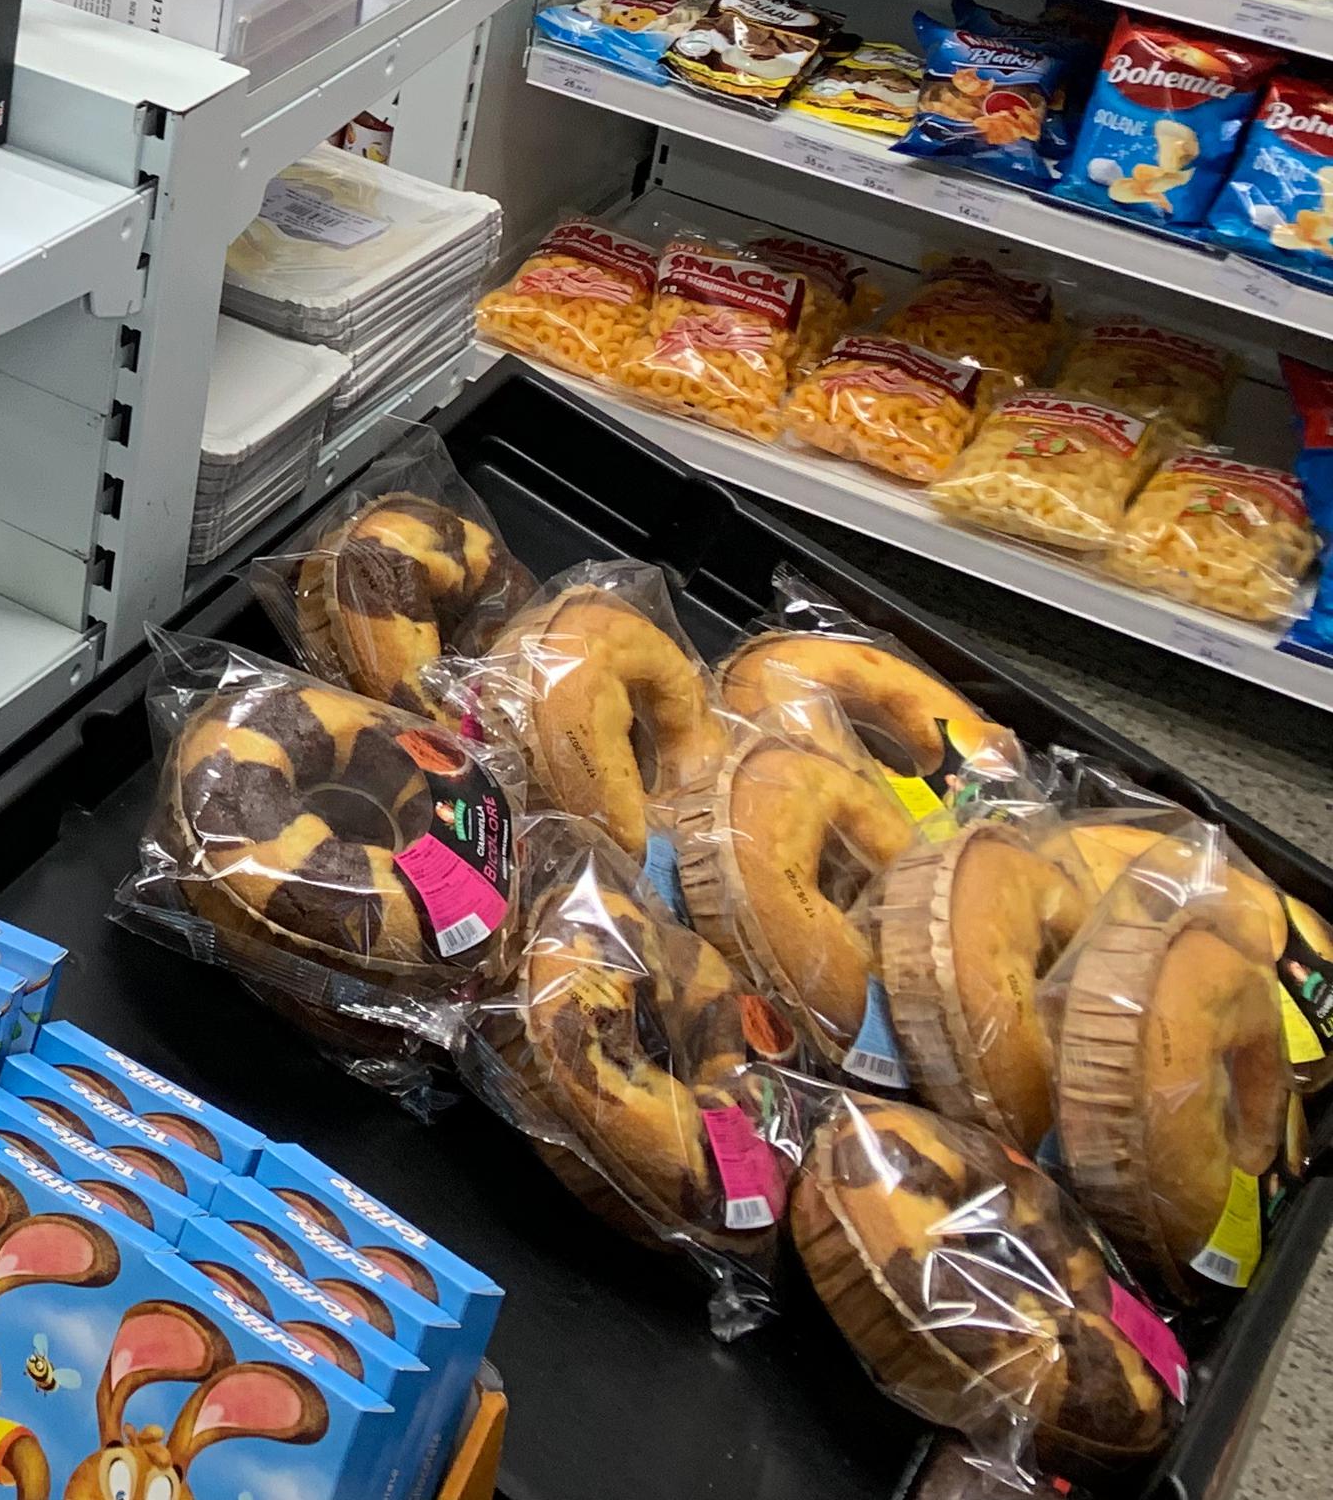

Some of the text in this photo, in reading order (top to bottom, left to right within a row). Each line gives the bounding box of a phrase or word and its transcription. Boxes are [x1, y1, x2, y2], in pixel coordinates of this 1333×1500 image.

[1110, 54, 1236, 99] Bohemia
[553, 223, 658, 267] SNACK
[667, 254, 788, 296] SNACK
[477, 805, 485, 857] CIAMBELLA
[484, 795, 500, 882] BICOLORE
[105, 1050, 205, 1113] Toffifee
[37, 1115, 138, 1181] Toffifee
[69, 1083, 172, 1147] Toffifee
[4, 1148, 106, 1214] Toffifee
[286, 1211, 383, 1283] Toffifee
[330, 1178, 430, 1251] Toffifee
[254, 1253, 354, 1326] Toffifee
[213, 1290, 318, 1366] Toffifee
